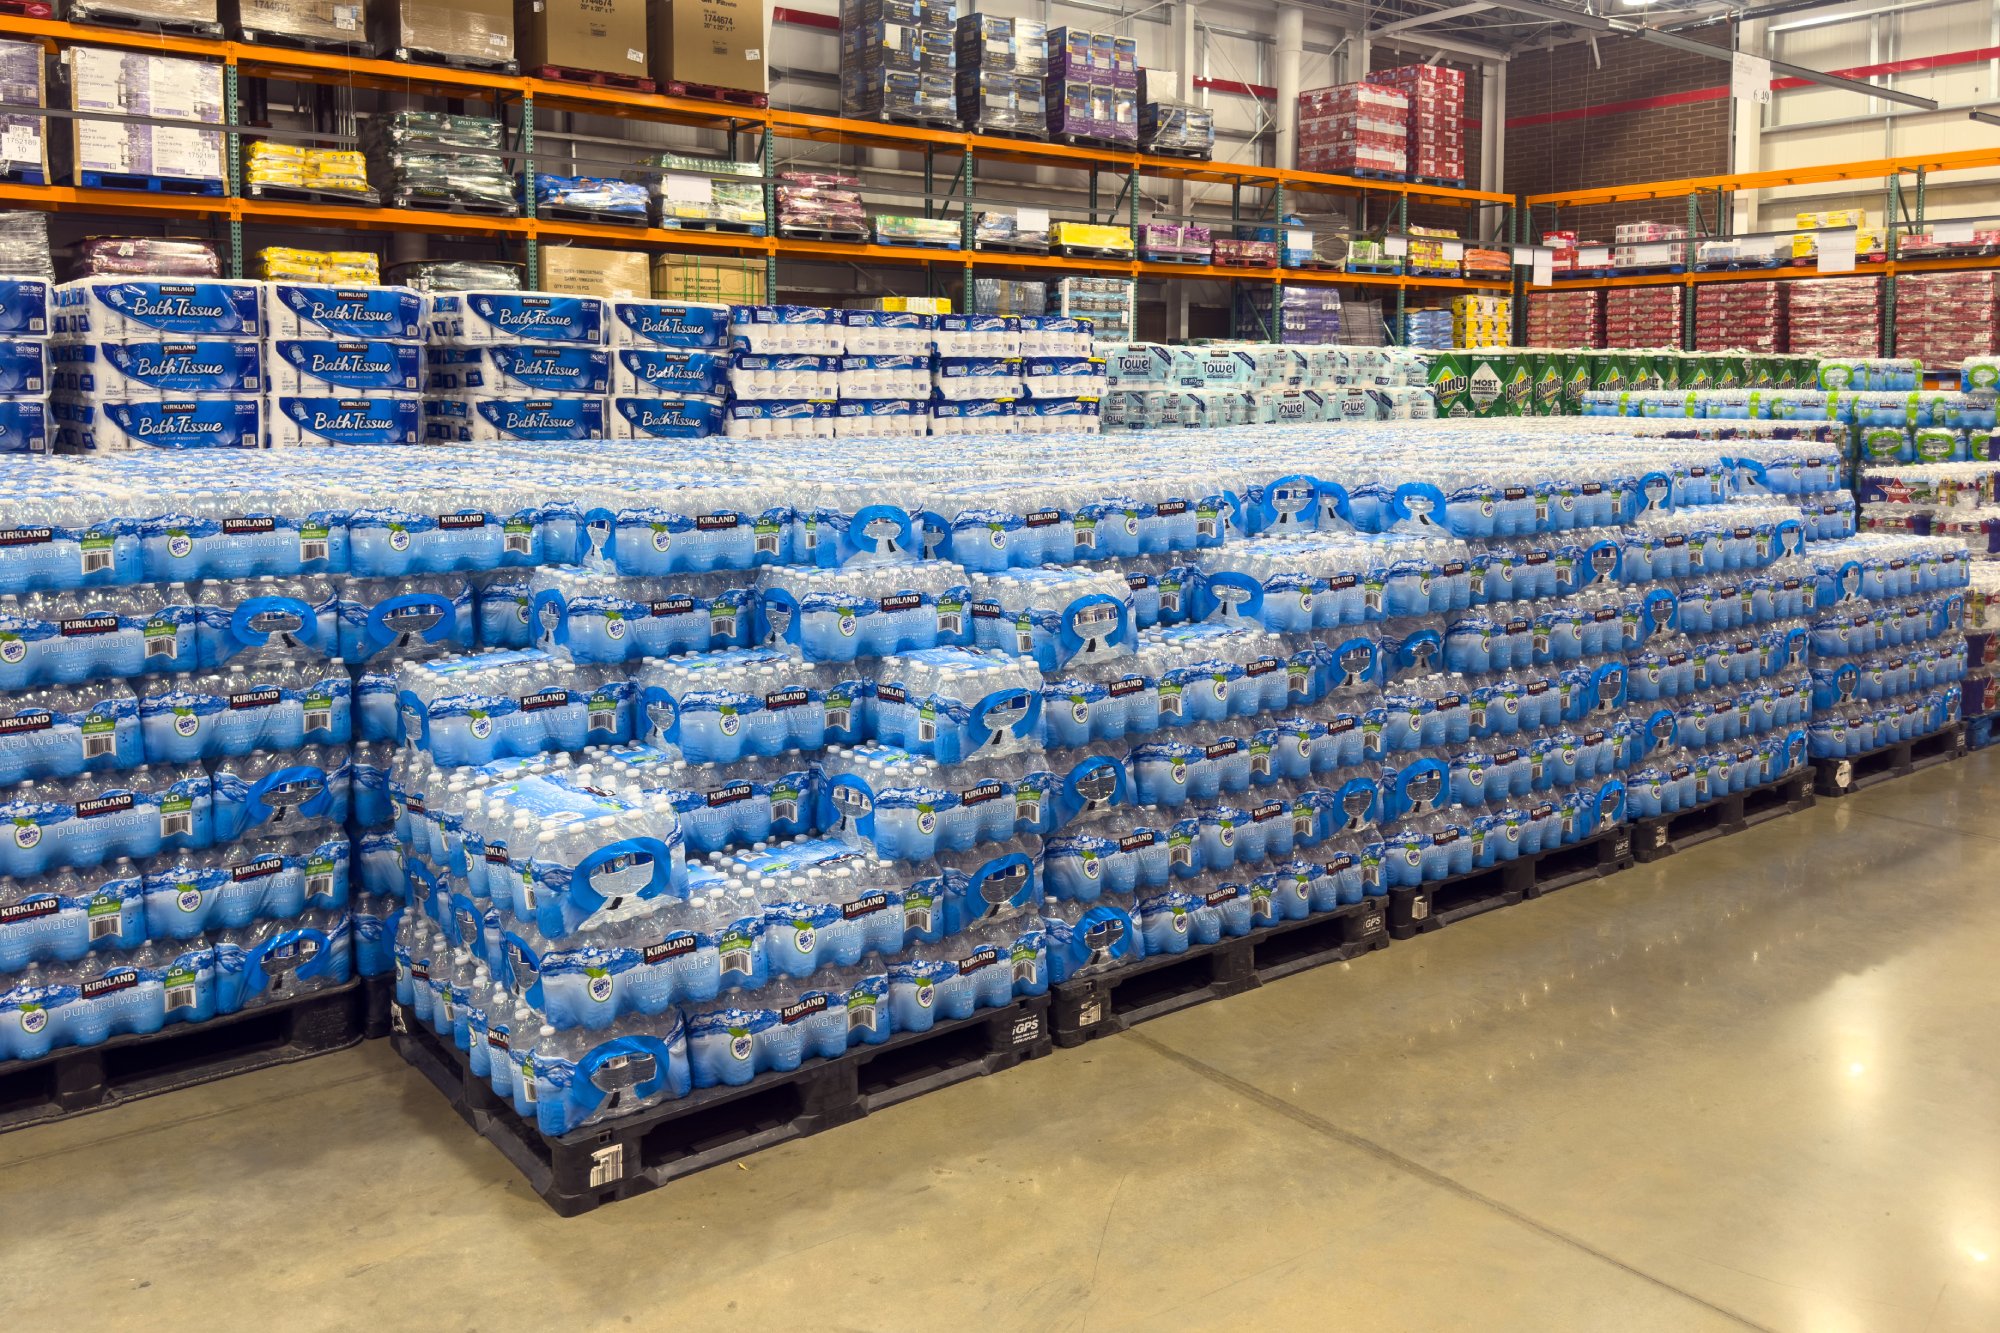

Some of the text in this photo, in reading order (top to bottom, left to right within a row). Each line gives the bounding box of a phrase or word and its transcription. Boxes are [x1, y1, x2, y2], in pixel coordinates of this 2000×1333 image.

[704, 14, 733, 25] 1744674
[134, 298, 223, 319] Bath Tissue
[312, 303, 393, 324] Bath Tissue
[499, 309, 571, 326] Bath Tissue
[641, 317, 704, 335] Bath Tissue
[164, 345, 197, 353] KIRKLAND
[138, 358, 224, 377] Bath Tissue
[312, 355, 392, 373] Bath Tissue
[514, 360, 579, 377] Bath Tissue
[1117, 356, 1152, 371] Towel
[1202, 361, 1236, 374] Towel
[646, 363, 704, 380] Bath Tissue
[1506, 376, 1532, 402] Bounty
[1536, 376, 1563, 400] Bounty
[162, 403, 196, 412] KIRKLAND
[139, 415, 223, 436] Bath Tissue
[314, 412, 394, 429] Bath Tissue
[506, 413, 575, 429] Bath Tissue
[642, 411, 701, 428] Bath Tissue
[441, 515, 483, 523] KIRKLAND
[699, 515, 736, 525] KIRKLAND
[1029, 511, 1059, 521] KIRKLAND
[225, 519, 273, 529] KIRKLAND
[653, 600, 692, 611] KIRKLAND
[884, 596, 919, 606] KIRKLAND
[64, 619, 116, 631] KIRKLAND
[146, 620, 164, 628] 40
[1111, 680, 1143, 691] KIRKLAND
[232, 691, 279, 704] KIRKLAND
[523, 692, 567, 706] KIRKLAND
[769, 692, 807, 703] KIRKLAND
[85, 715, 102, 723] 40
[163, 794, 179, 803] 40
[710, 786, 750, 801] KIRKLAND
[964, 785, 1000, 800] KIRKLAND
[79, 796, 131, 811] KIRKLAND
[235, 858, 281, 875] KIRKLAND
[308, 856, 322, 866] 40
[2, 899, 57, 916] KIRKLAND
[91, 896, 108, 905] 40
[845, 895, 885, 912] KIRKLAND
[721, 931, 738, 941] 40
[646, 936, 695, 957] KIRKLAND
[961, 950, 995, 968] KIRKLAND
[168, 967, 183, 977] 40
[626, 953, 717, 987] purified water
[85, 971, 136, 994] KIRKLAND
[593, 981, 611, 994] 50%
[784, 996, 825, 1017] KIRKLAND
[1012, 1019, 1039, 1035] iGPS
